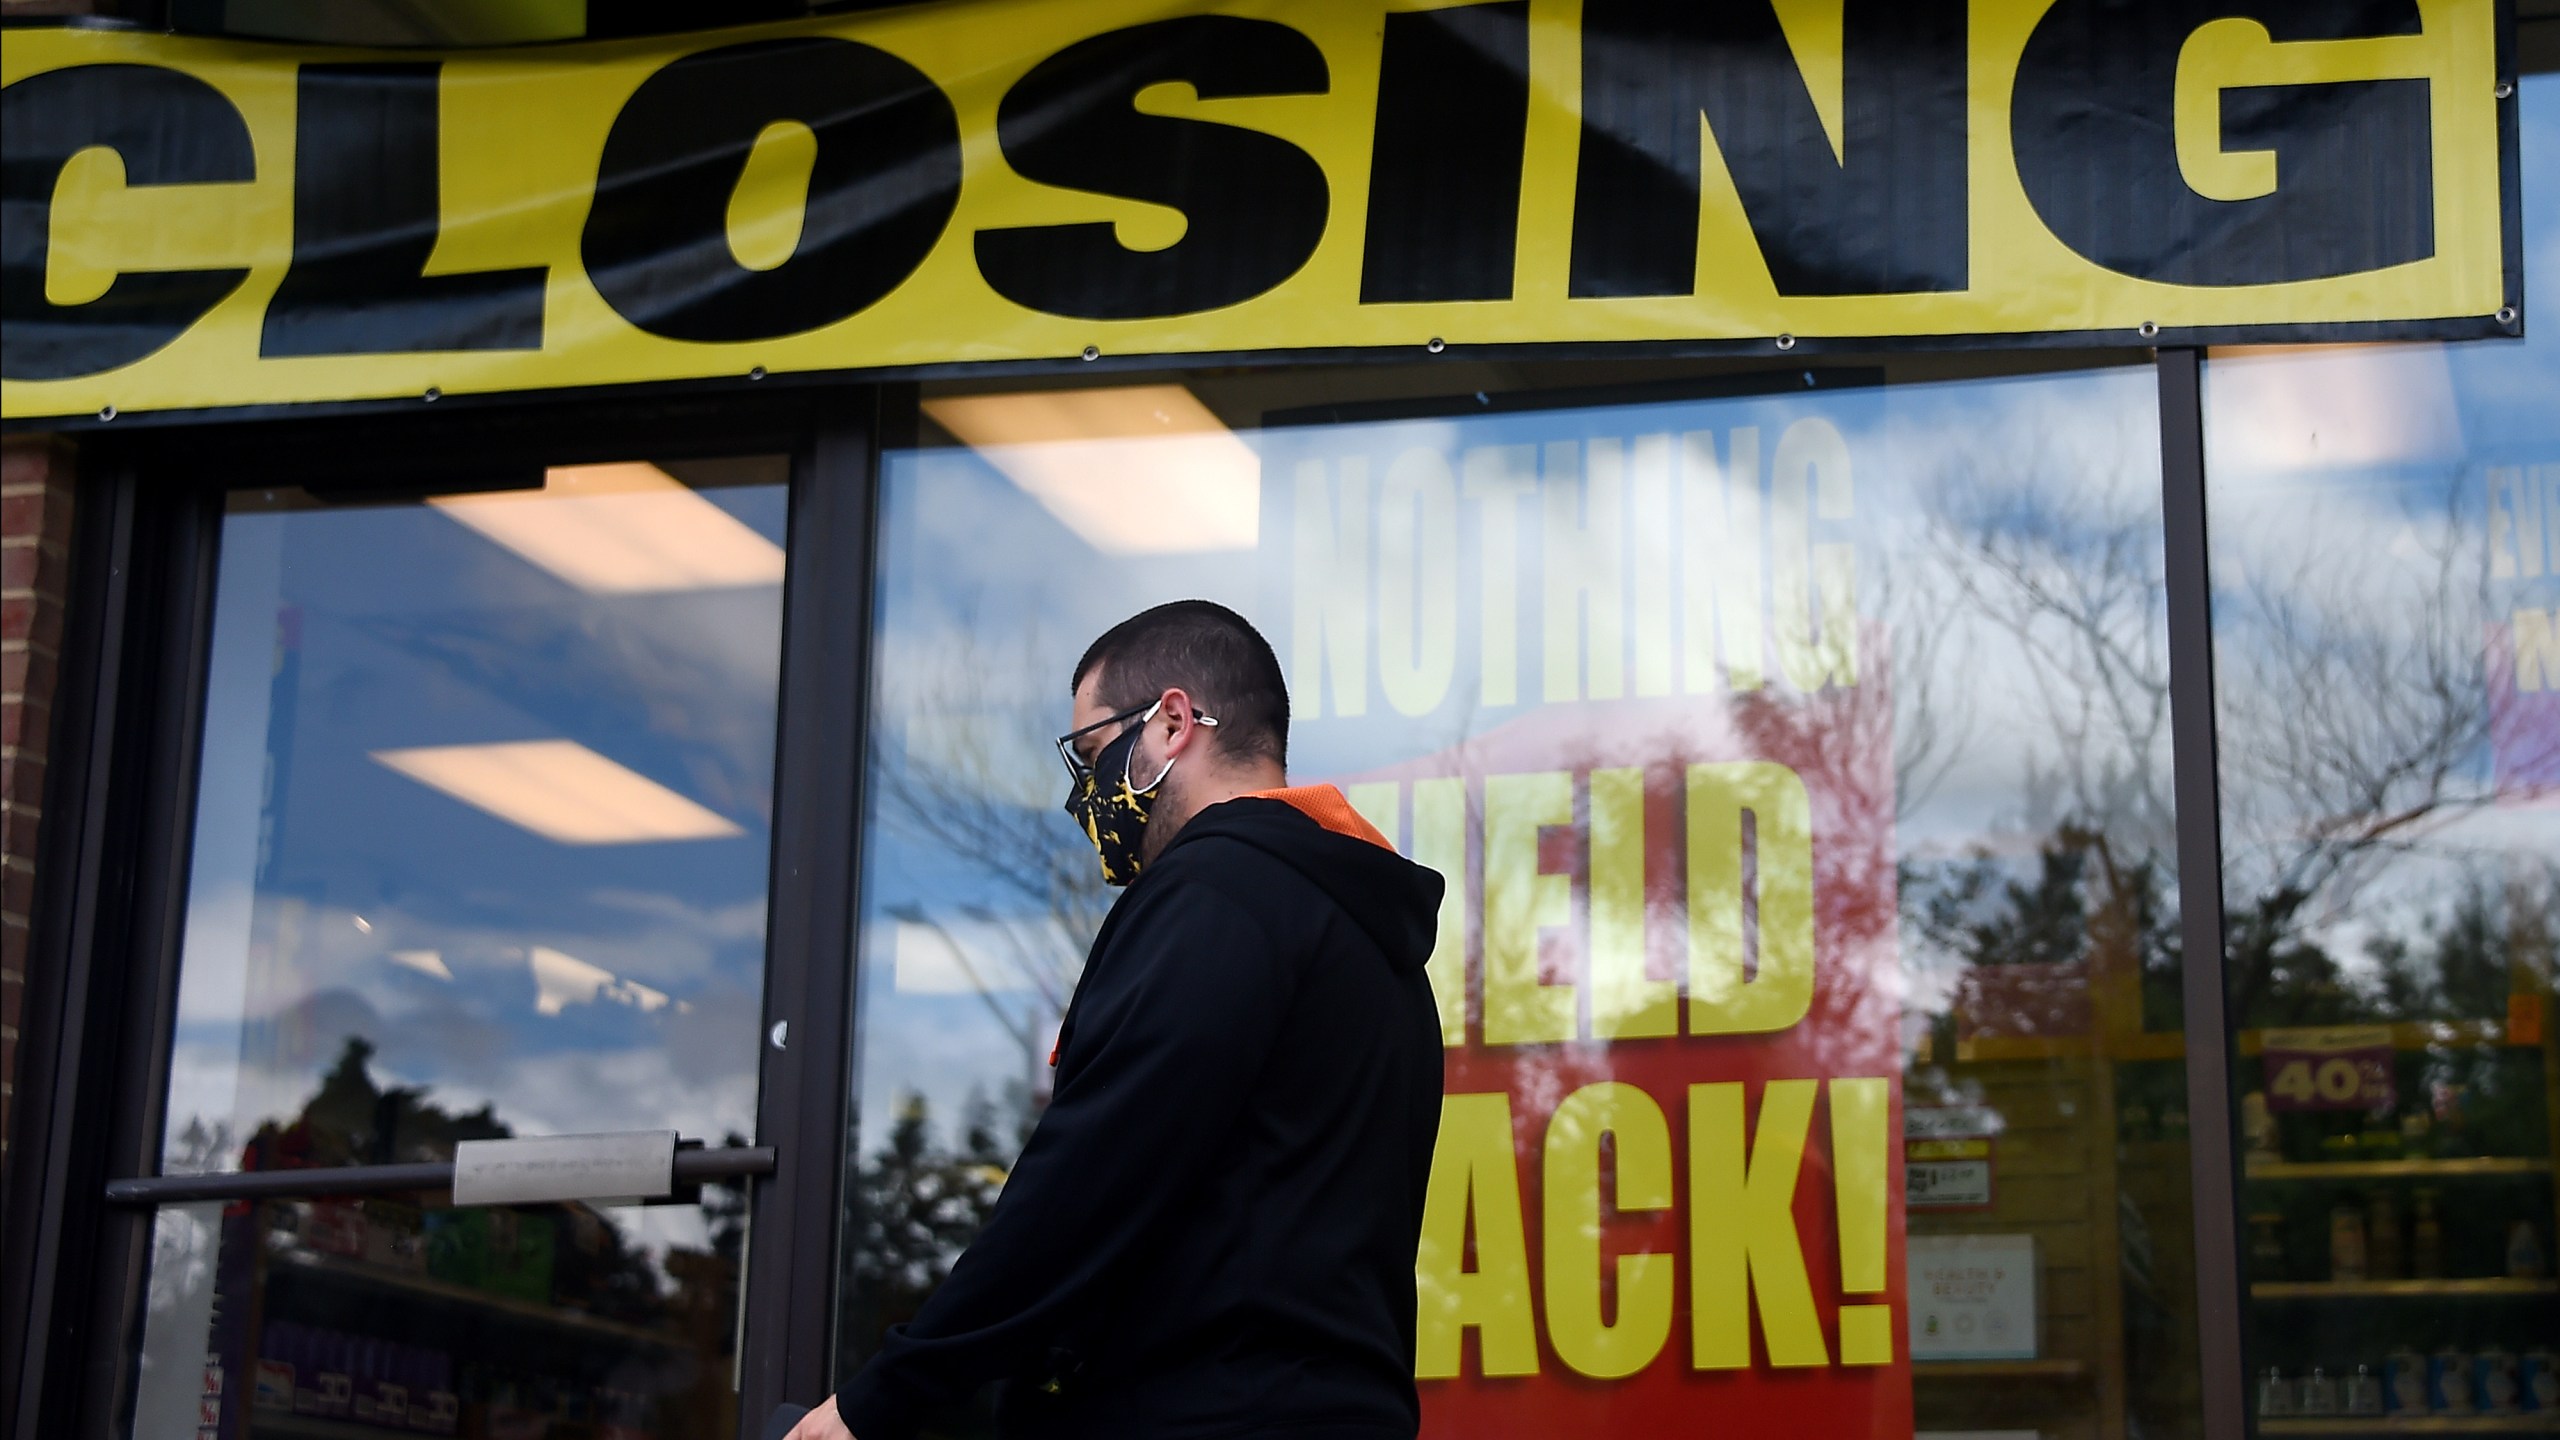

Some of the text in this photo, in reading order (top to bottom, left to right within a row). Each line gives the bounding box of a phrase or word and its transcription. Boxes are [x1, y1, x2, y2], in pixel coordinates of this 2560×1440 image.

[0, 0, 2436, 380] CLOSING
[1290, 416, 1858, 722] NOTHING
[1414, 1076, 1895, 1379] ACK!
